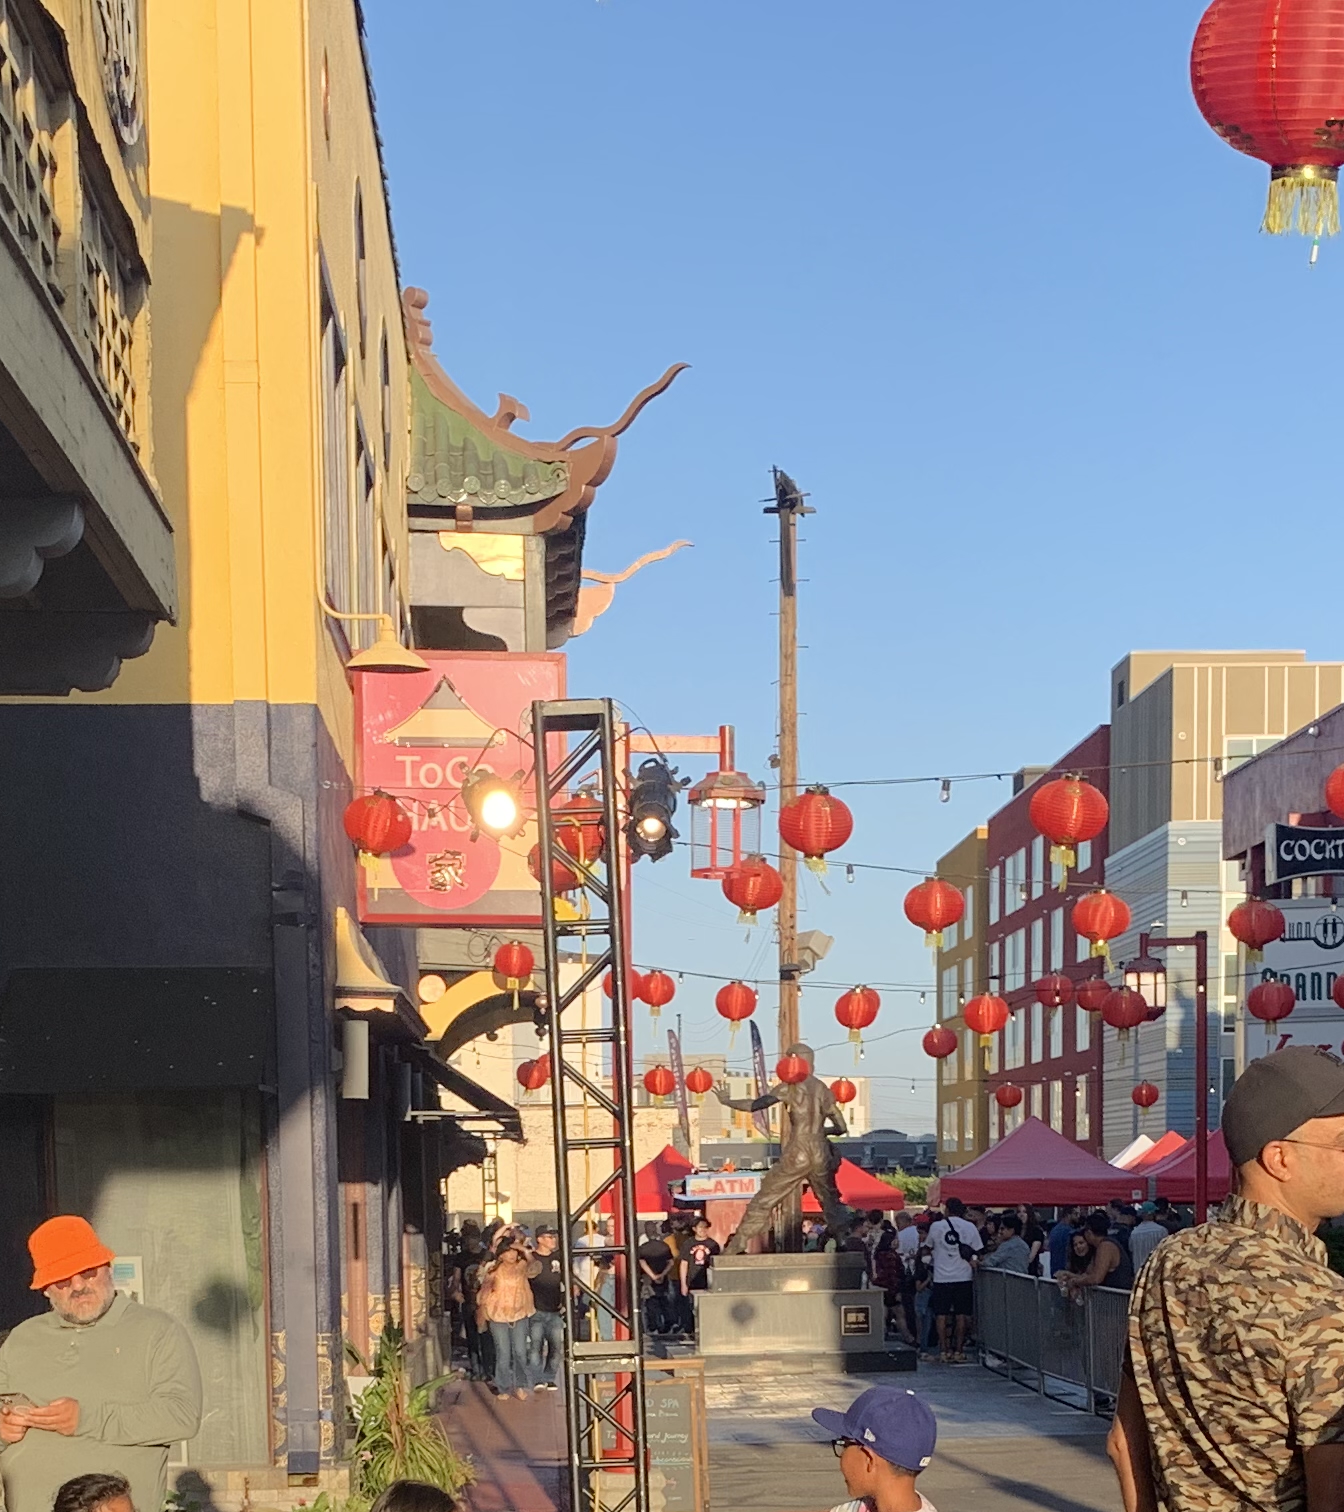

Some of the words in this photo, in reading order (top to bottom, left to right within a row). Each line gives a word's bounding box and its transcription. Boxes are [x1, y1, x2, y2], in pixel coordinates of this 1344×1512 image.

[426, 849, 467, 892] 家
[713, 1179, 755, 1194] ATM
[659, 1398, 680, 1409] SPA
